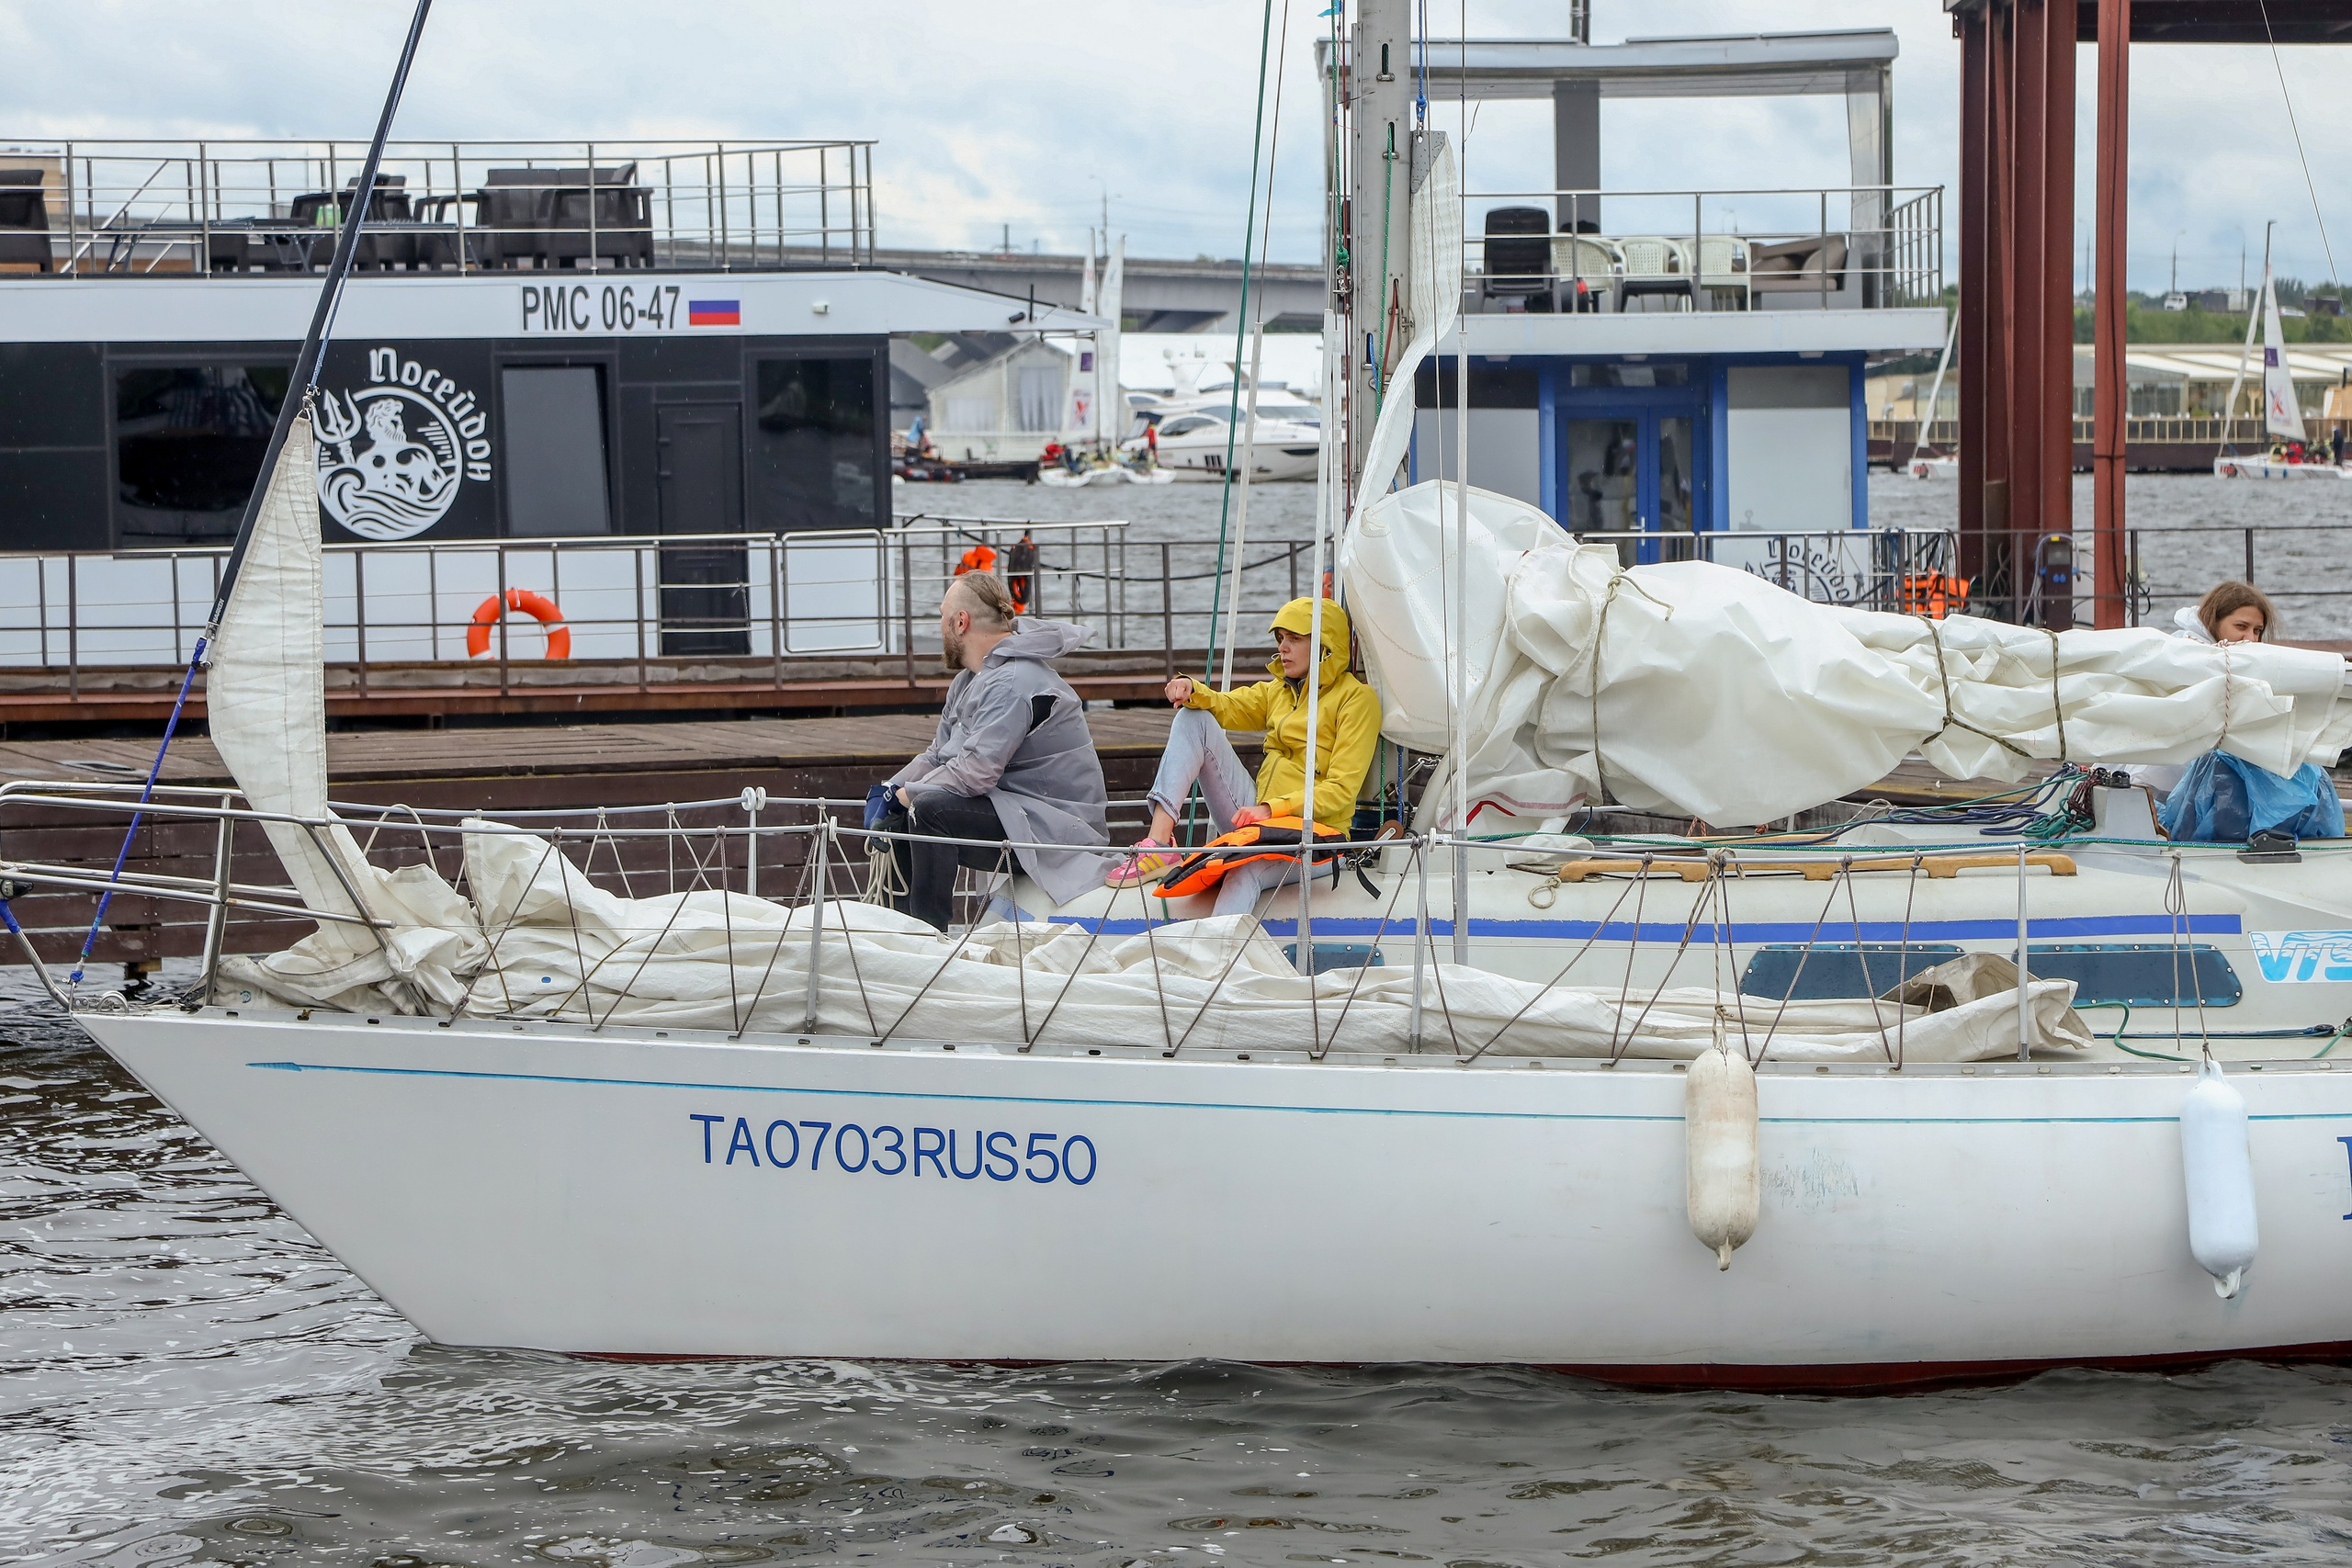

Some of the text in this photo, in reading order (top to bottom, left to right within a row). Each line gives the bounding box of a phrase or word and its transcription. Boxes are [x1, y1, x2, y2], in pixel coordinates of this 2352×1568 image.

[602, 285, 682, 331] 06-47
[368, 346, 492, 482] Посейдон
[689, 1113, 1097, 1186] TA0703RUS50
